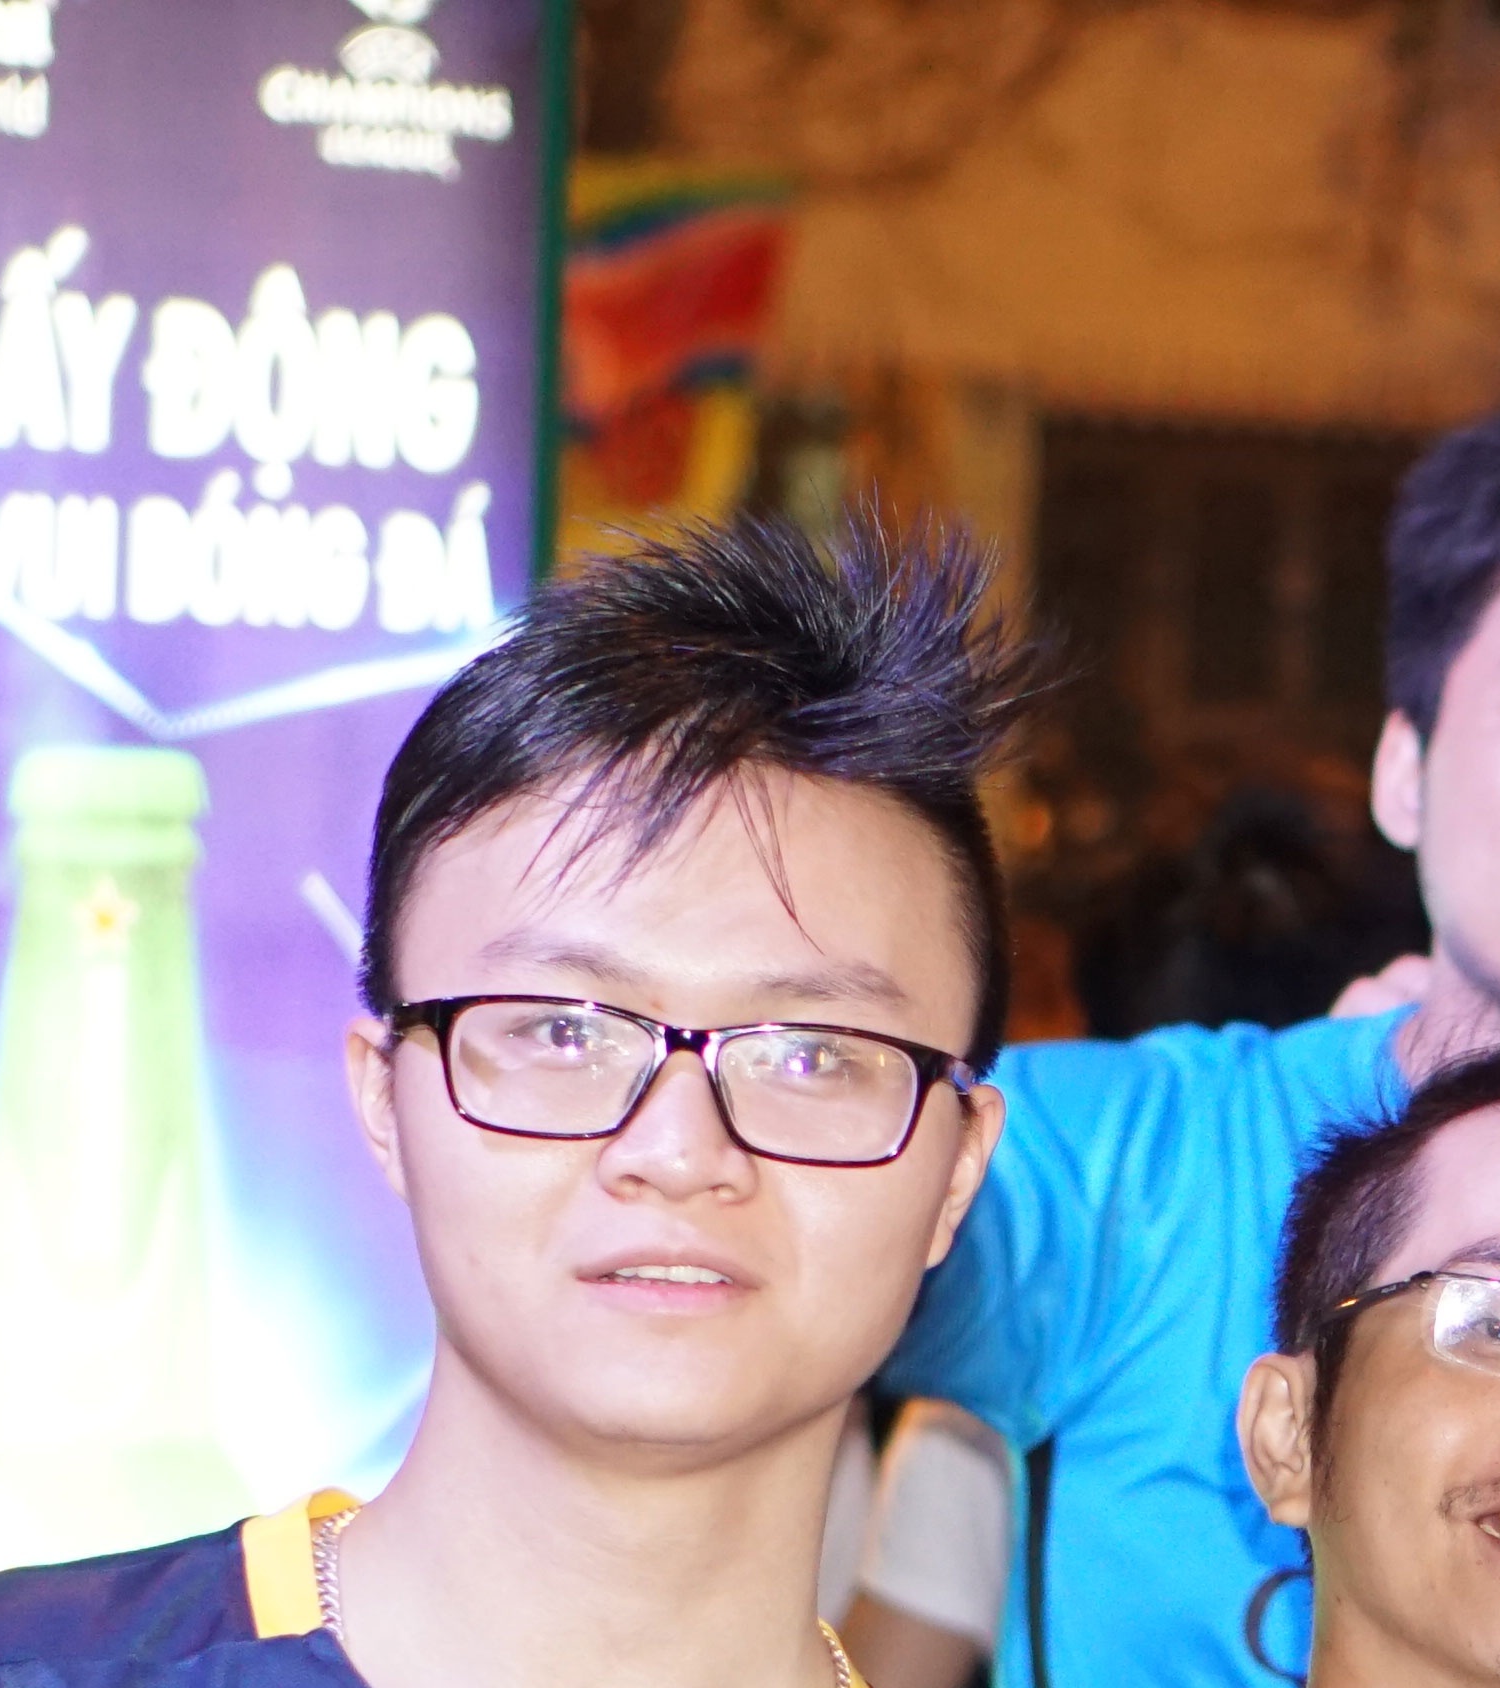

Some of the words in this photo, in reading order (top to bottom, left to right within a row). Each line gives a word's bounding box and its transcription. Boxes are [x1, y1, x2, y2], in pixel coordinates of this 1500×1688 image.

[142, 264, 479, 500] ĐỘNG
[126, 468, 370, 631] BÓNG
[376, 481, 494, 635] ĐÁ
